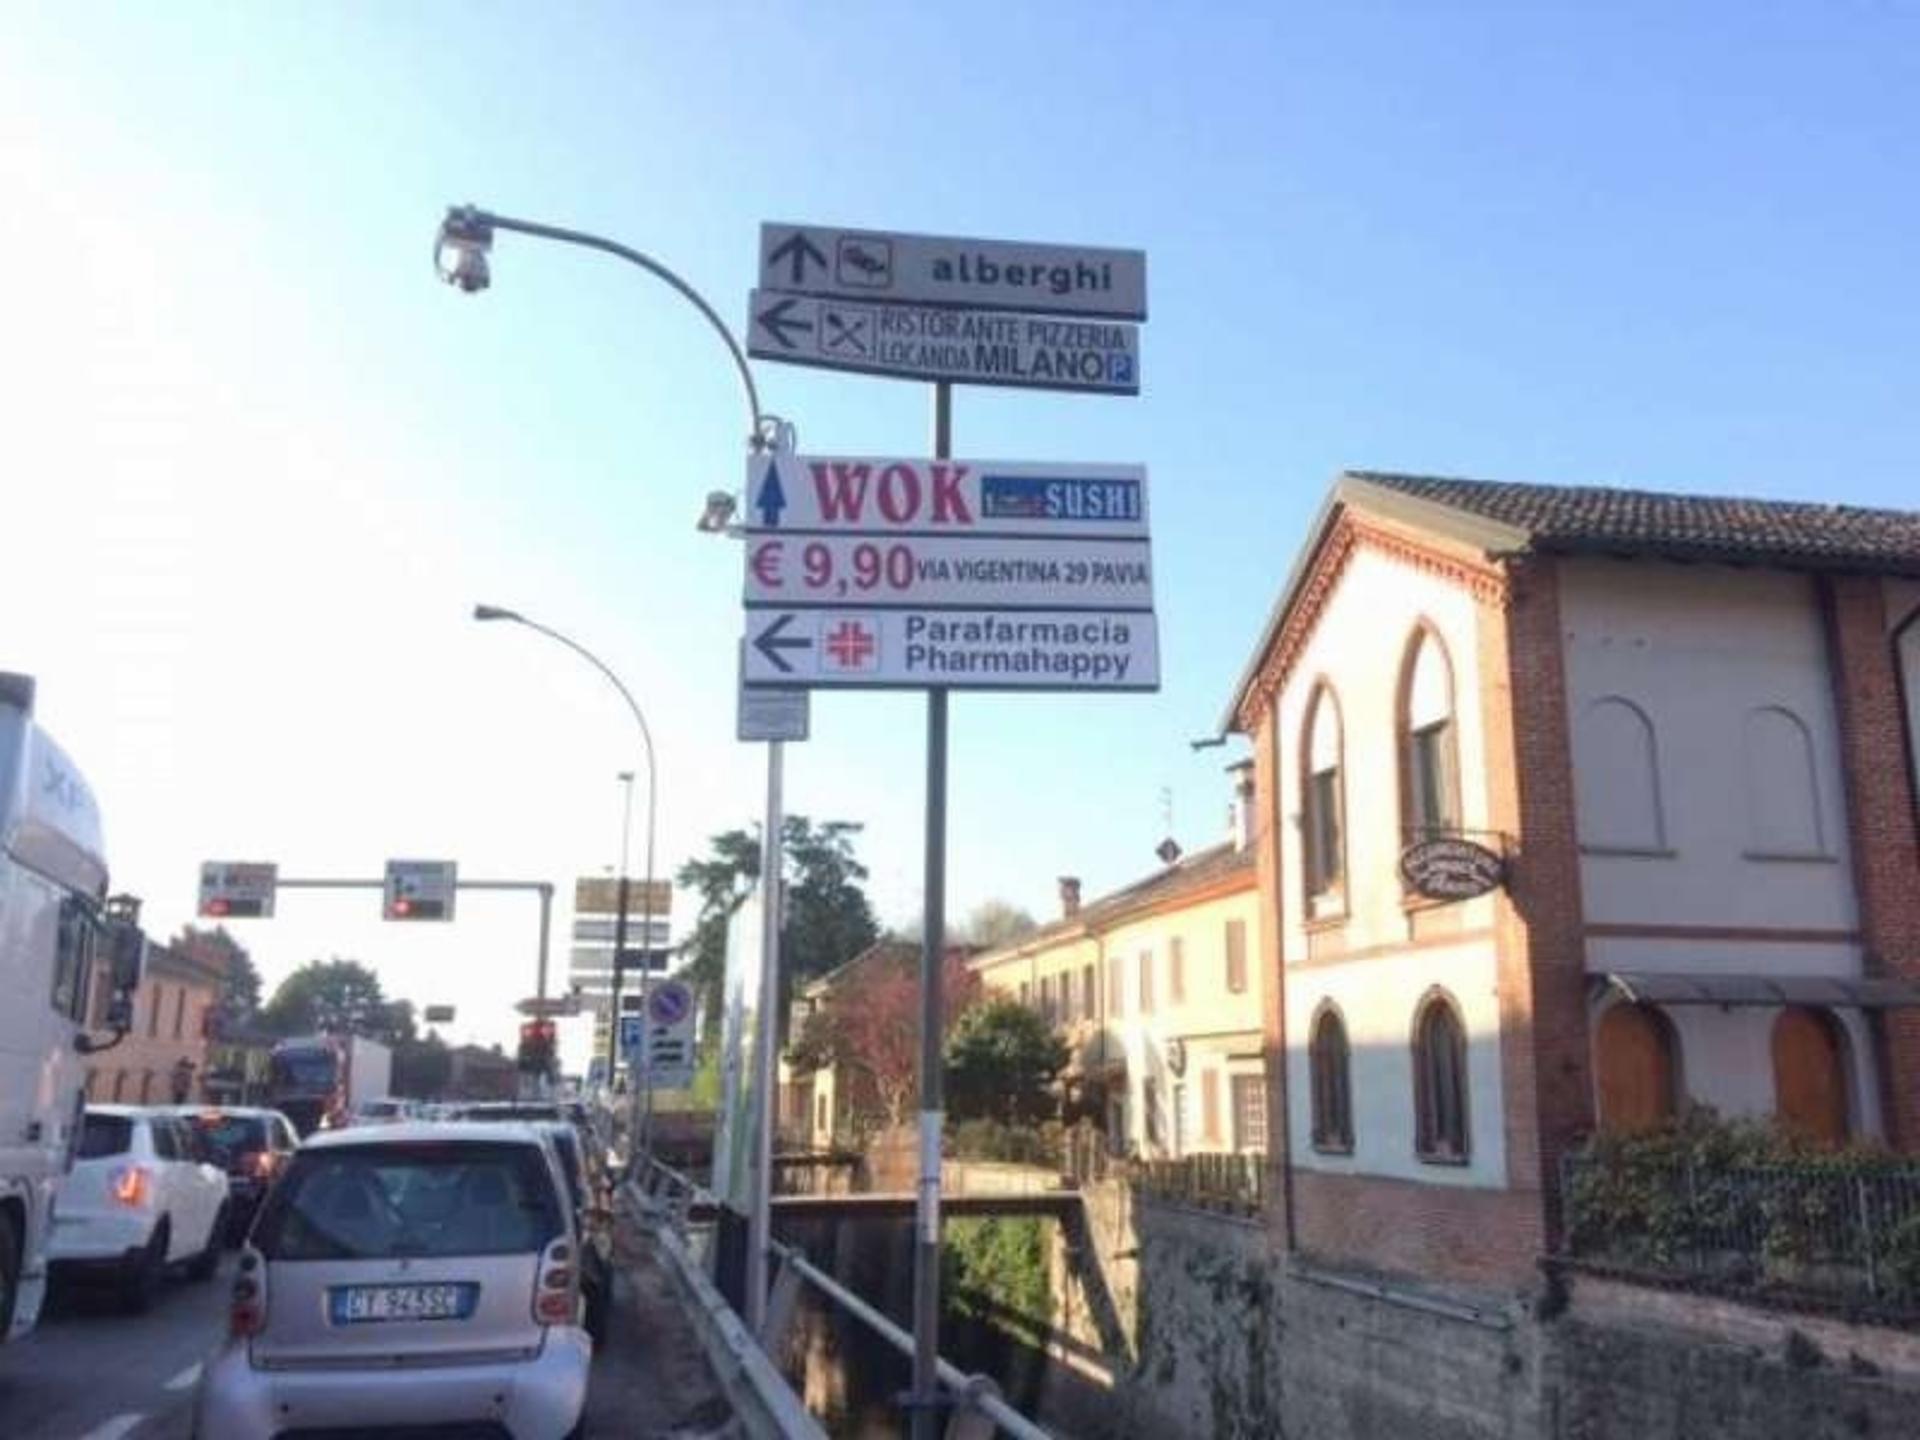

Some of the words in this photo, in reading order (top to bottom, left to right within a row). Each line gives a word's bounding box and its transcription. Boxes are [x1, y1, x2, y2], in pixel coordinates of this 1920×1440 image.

[933, 253, 1112, 294] alberghi
[880, 306, 1019, 346] RISTORANTE
[1027, 319, 1126, 349] PIZZERIA
[880, 339, 972, 370] LOCANDA
[975, 345, 1104, 380] MILANO
[808, 462, 974, 525] WOK
[1046, 482, 1139, 519] SUSHI
[753, 540, 785, 588] €
[802, 542, 915, 596] 9,90
[918, 556, 952, 580] VIA
[954, 557, 1060, 584] VIGENTINA
[1064, 562, 1089, 584] 29
[1092, 562, 1148, 586] PAVIA
[906, 614, 1131, 645] Parafarmacia
[906, 644, 1131, 679] Pharmahappy
